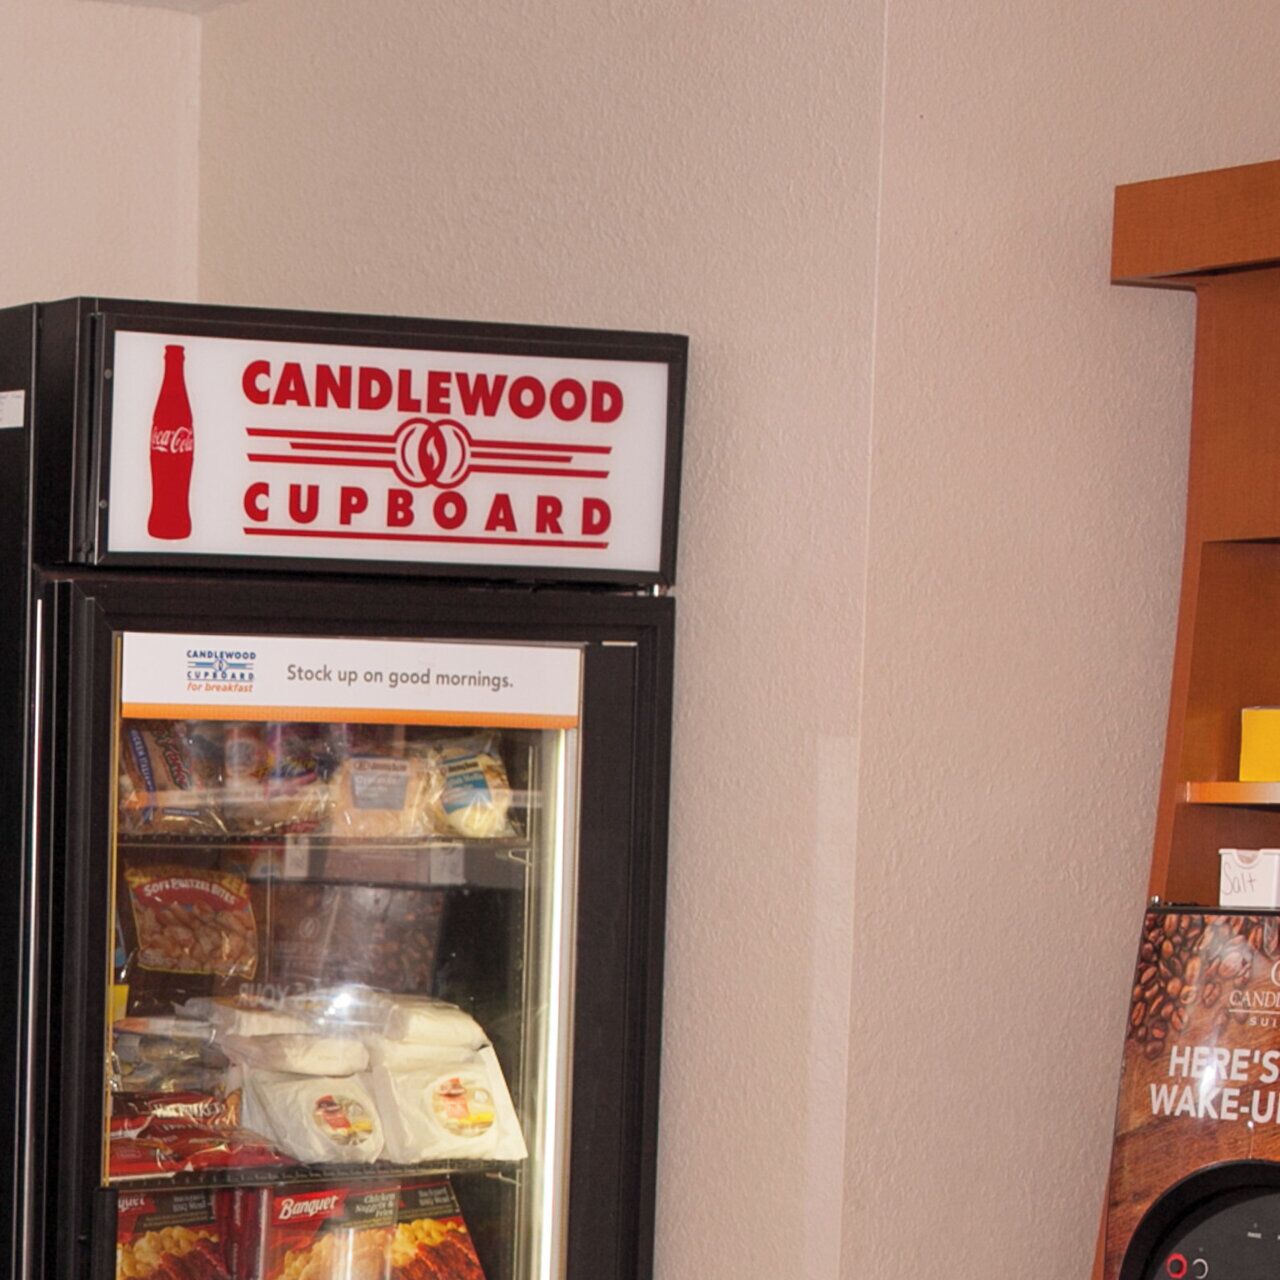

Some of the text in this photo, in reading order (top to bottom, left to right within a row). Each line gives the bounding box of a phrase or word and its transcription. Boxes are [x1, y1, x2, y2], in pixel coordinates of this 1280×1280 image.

[241, 360, 623, 423] CANDLEWOOD
[244, 482, 611, 536] CUPBOARD
[187, 650, 256, 660] CANDLEWOOD
[187, 670, 254, 680] CUPBOARD
[187, 682, 253, 693] for breakfast
[287, 664, 513, 692] Stock up on good mornings.
[1222, 861, 1256, 895] Salt
[1169, 1045, 1280, 1084] HERE'S
[278, 1196, 339, 1220] Banquet
